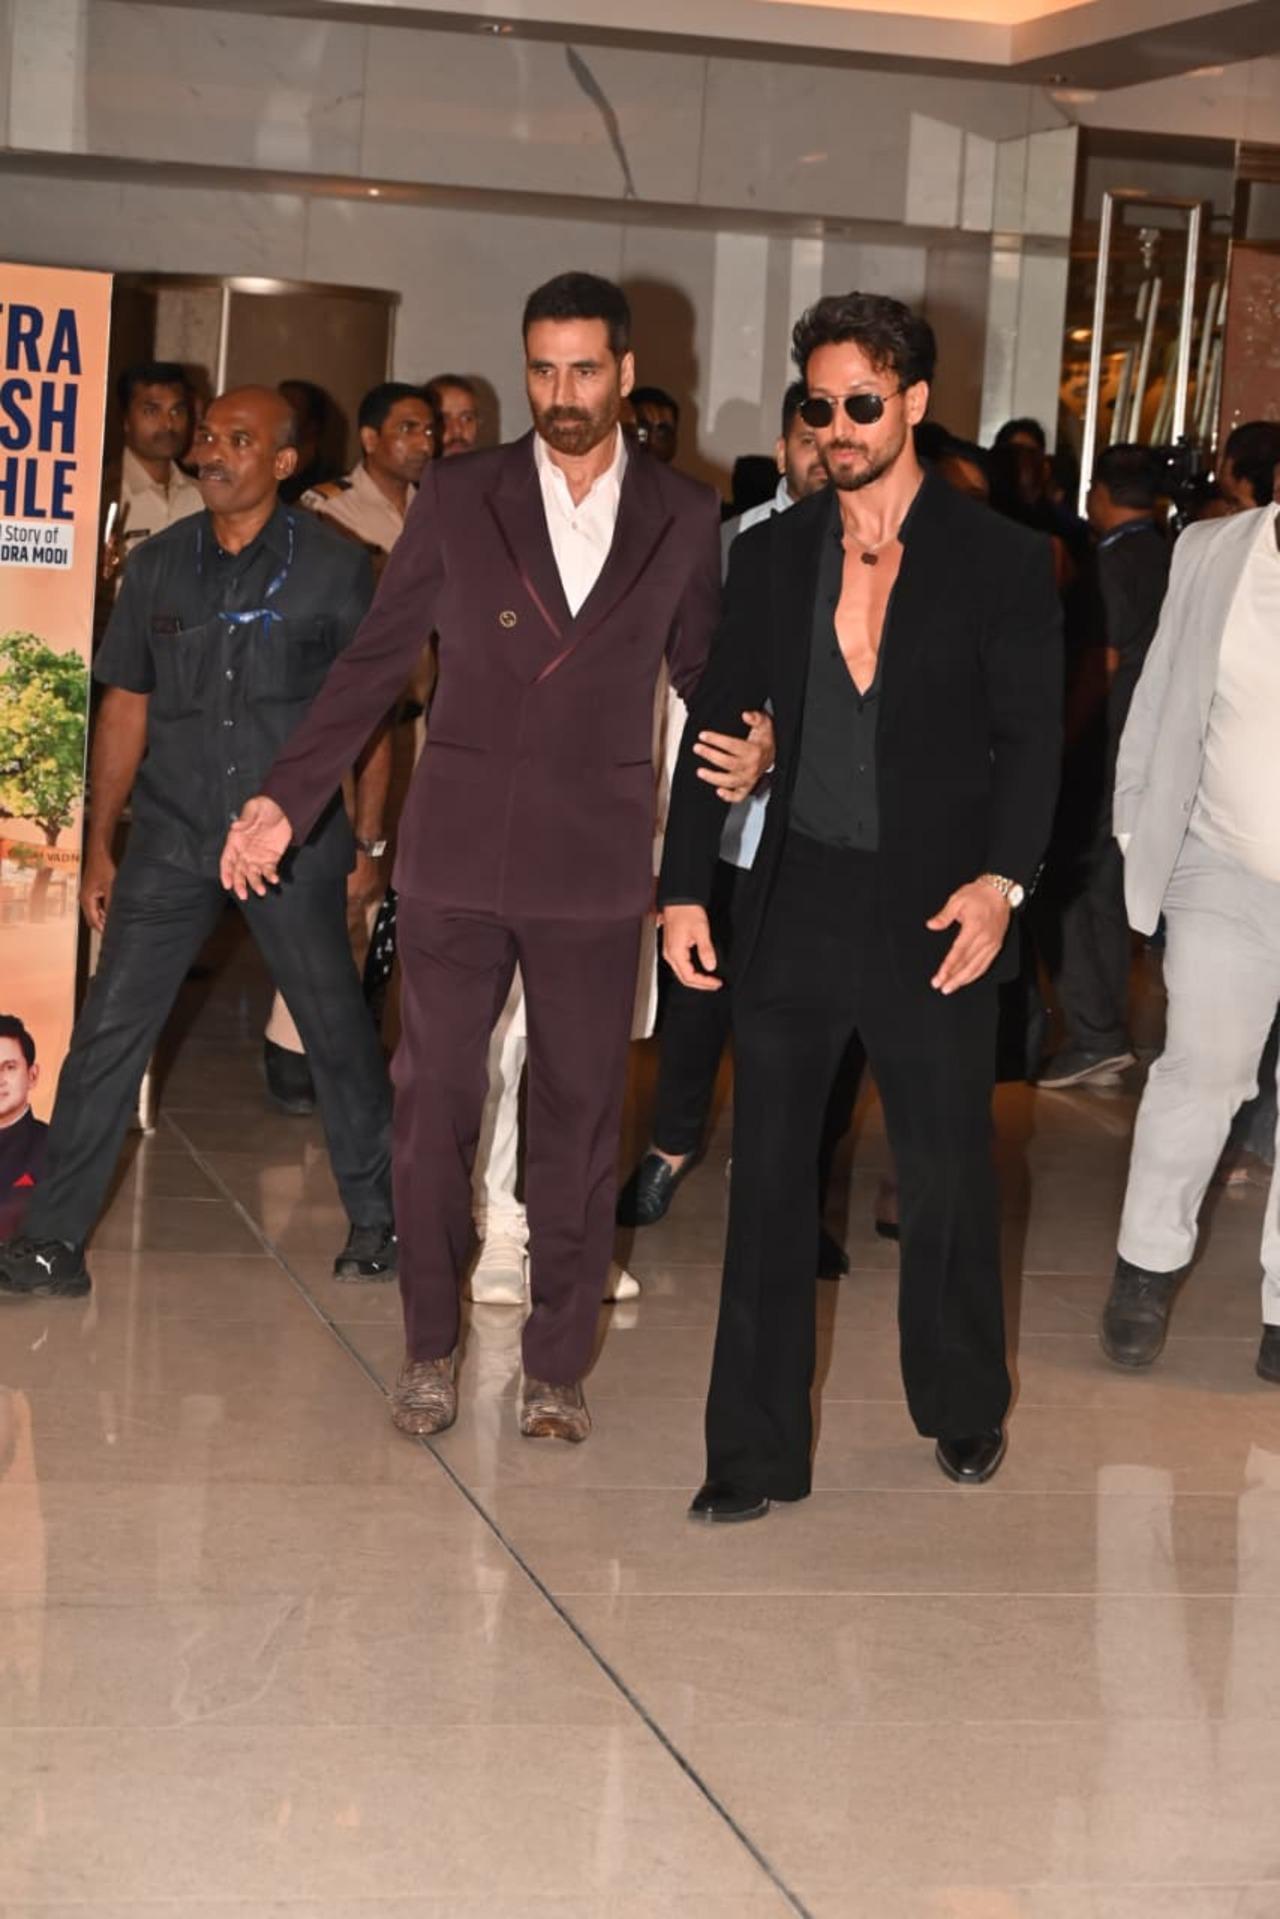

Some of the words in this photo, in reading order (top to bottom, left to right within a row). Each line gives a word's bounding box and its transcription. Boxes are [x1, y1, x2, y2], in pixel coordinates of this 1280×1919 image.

[0, 303, 82, 375] RA
[0, 378, 78, 454] SH
[1, 545, 28, 562] DRA
[32, 546, 68, 564] MODI
[5, 524, 41, 545] Story
[45, 527, 58, 544] of
